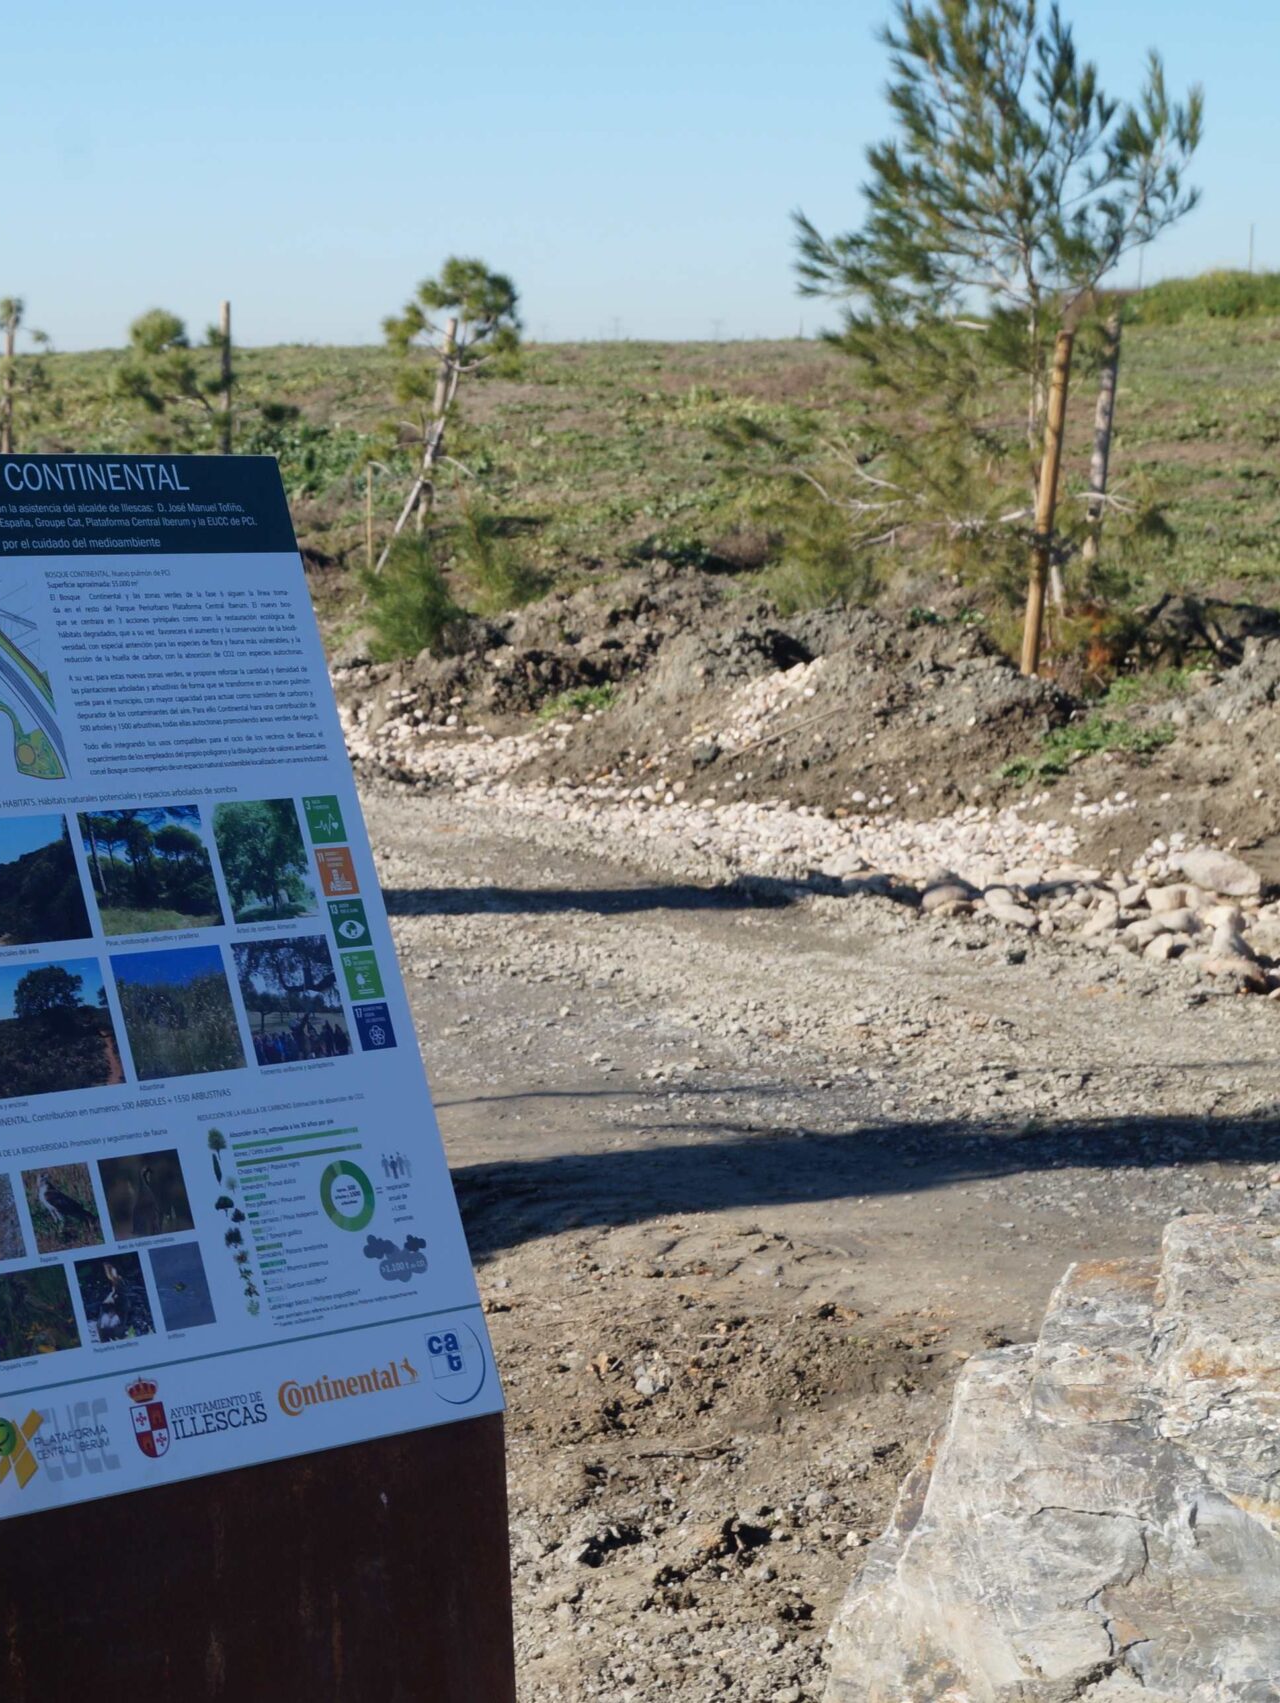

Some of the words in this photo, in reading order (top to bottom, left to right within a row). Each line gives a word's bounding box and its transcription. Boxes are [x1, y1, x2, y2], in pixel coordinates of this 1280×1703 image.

[4, 463, 190, 492] CONTINENTAL
[9, 504, 17, 513] la
[18, 503, 61, 513] asistencia
[62, 503, 75, 512] del
[77, 503, 107, 512] alcalde
[108, 503, 119, 512] de
[121, 503, 153, 512] Illescas:
[157, 503, 166, 512] D.
[168, 503, 185, 512] José
[187, 503, 216, 512] Manuel
[219, 503, 244, 513] Tofiño,
[0, 517, 33, 529] España,
[35, 517, 65, 529] Groupe
[67, 517, 84, 529] Cat,
[85, 517, 129, 527] Plataforma
[131, 517, 160, 526] Central
[162, 517, 190, 526] Iberum
[198, 516, 205, 526] la
[207, 516, 228, 526] EUCC
[229, 516, 240, 526] de
[2, 541, 18, 550] por
[20, 538, 29, 548] el
[31, 538, 70, 548] cuidado
[71, 537, 86, 548] del
[89, 537, 160, 547] medioambiente
[67, 794, 97, 803] naturales
[99, 791, 136, 802] potenciales
[142, 789, 170, 799] espacios
[172, 787, 202, 796] arbolados
[204, 786, 211, 794] de
[213, 785, 237, 794] sombra
[330, 904, 338, 914] 13
[122, 1101, 134, 1110] 500
[191, 1088, 231, 1101] ARBUSTIVAS
[277, 1360, 401, 1417] Continental
[170, 1394, 247, 1419] AYUNTAMIENTO
[249, 1391, 263, 1403] DE
[171, 1403, 268, 1440] ILLESCAS
[34, 1424, 108, 1447] PLATAFORMA
[35, 1448, 76, 1461] CENTRAL
